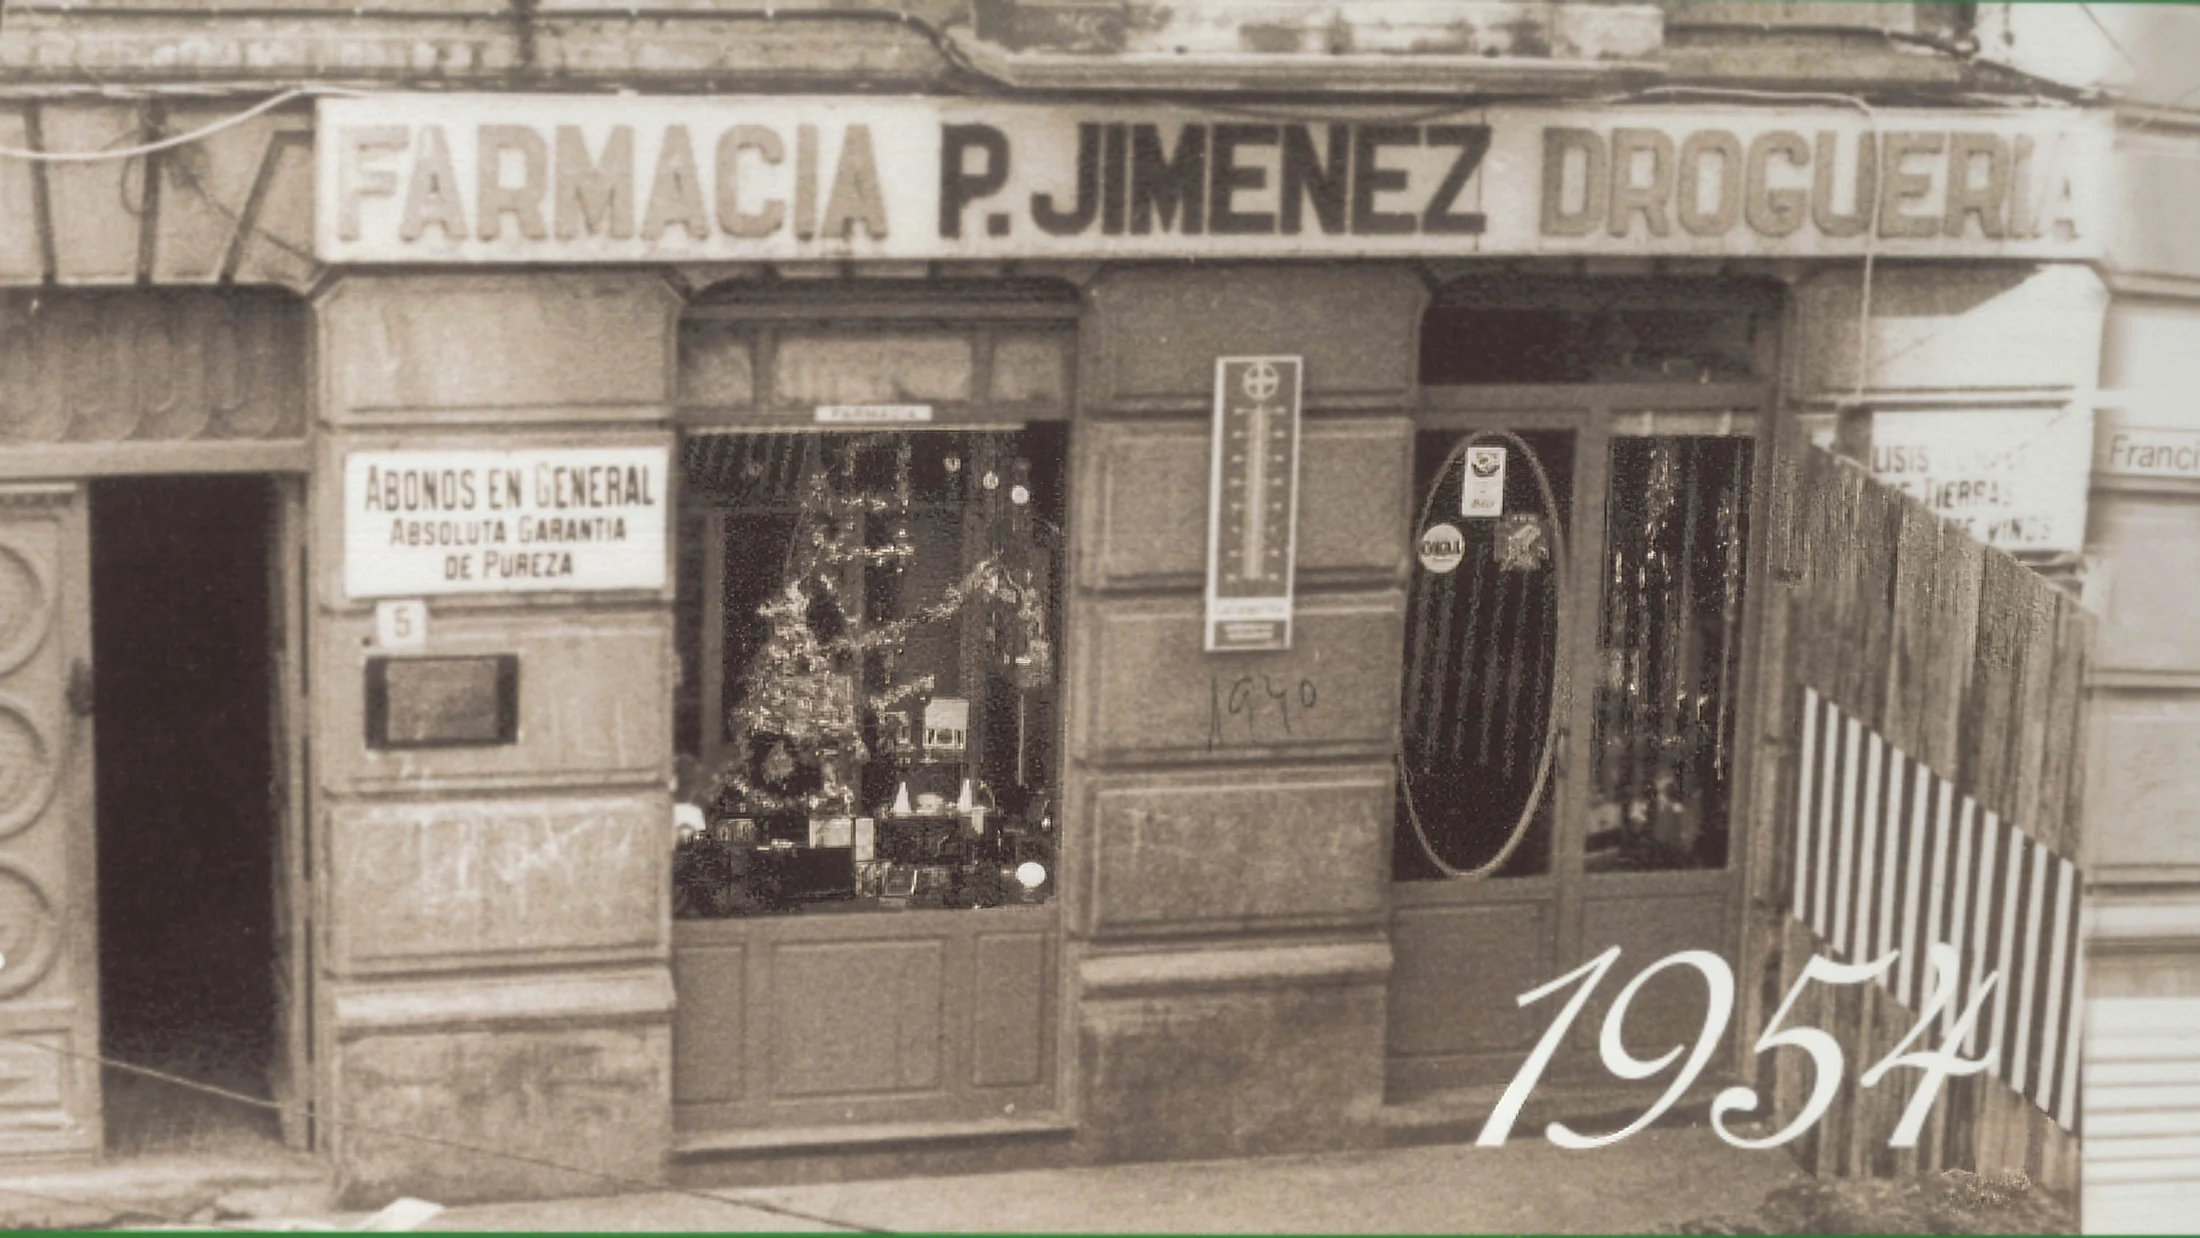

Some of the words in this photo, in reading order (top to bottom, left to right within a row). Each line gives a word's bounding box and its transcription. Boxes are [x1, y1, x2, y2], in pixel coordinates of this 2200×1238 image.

[337, 124, 888, 242] FARMACIA
[939, 122, 1010, 239] P.
[1030, 122, 1492, 236] JIMENEZ
[1540, 127, 2082, 240] DROGUERIA
[364, 464, 476, 512] ABONOS
[488, 468, 524, 512] EN
[534, 461, 656, 509] GENERAL
[389, 517, 508, 547] ABSOLUTA
[518, 514, 627, 544] GARANTIA
[444, 554, 473, 581] DE
[483, 551, 574, 579] PUREZA
